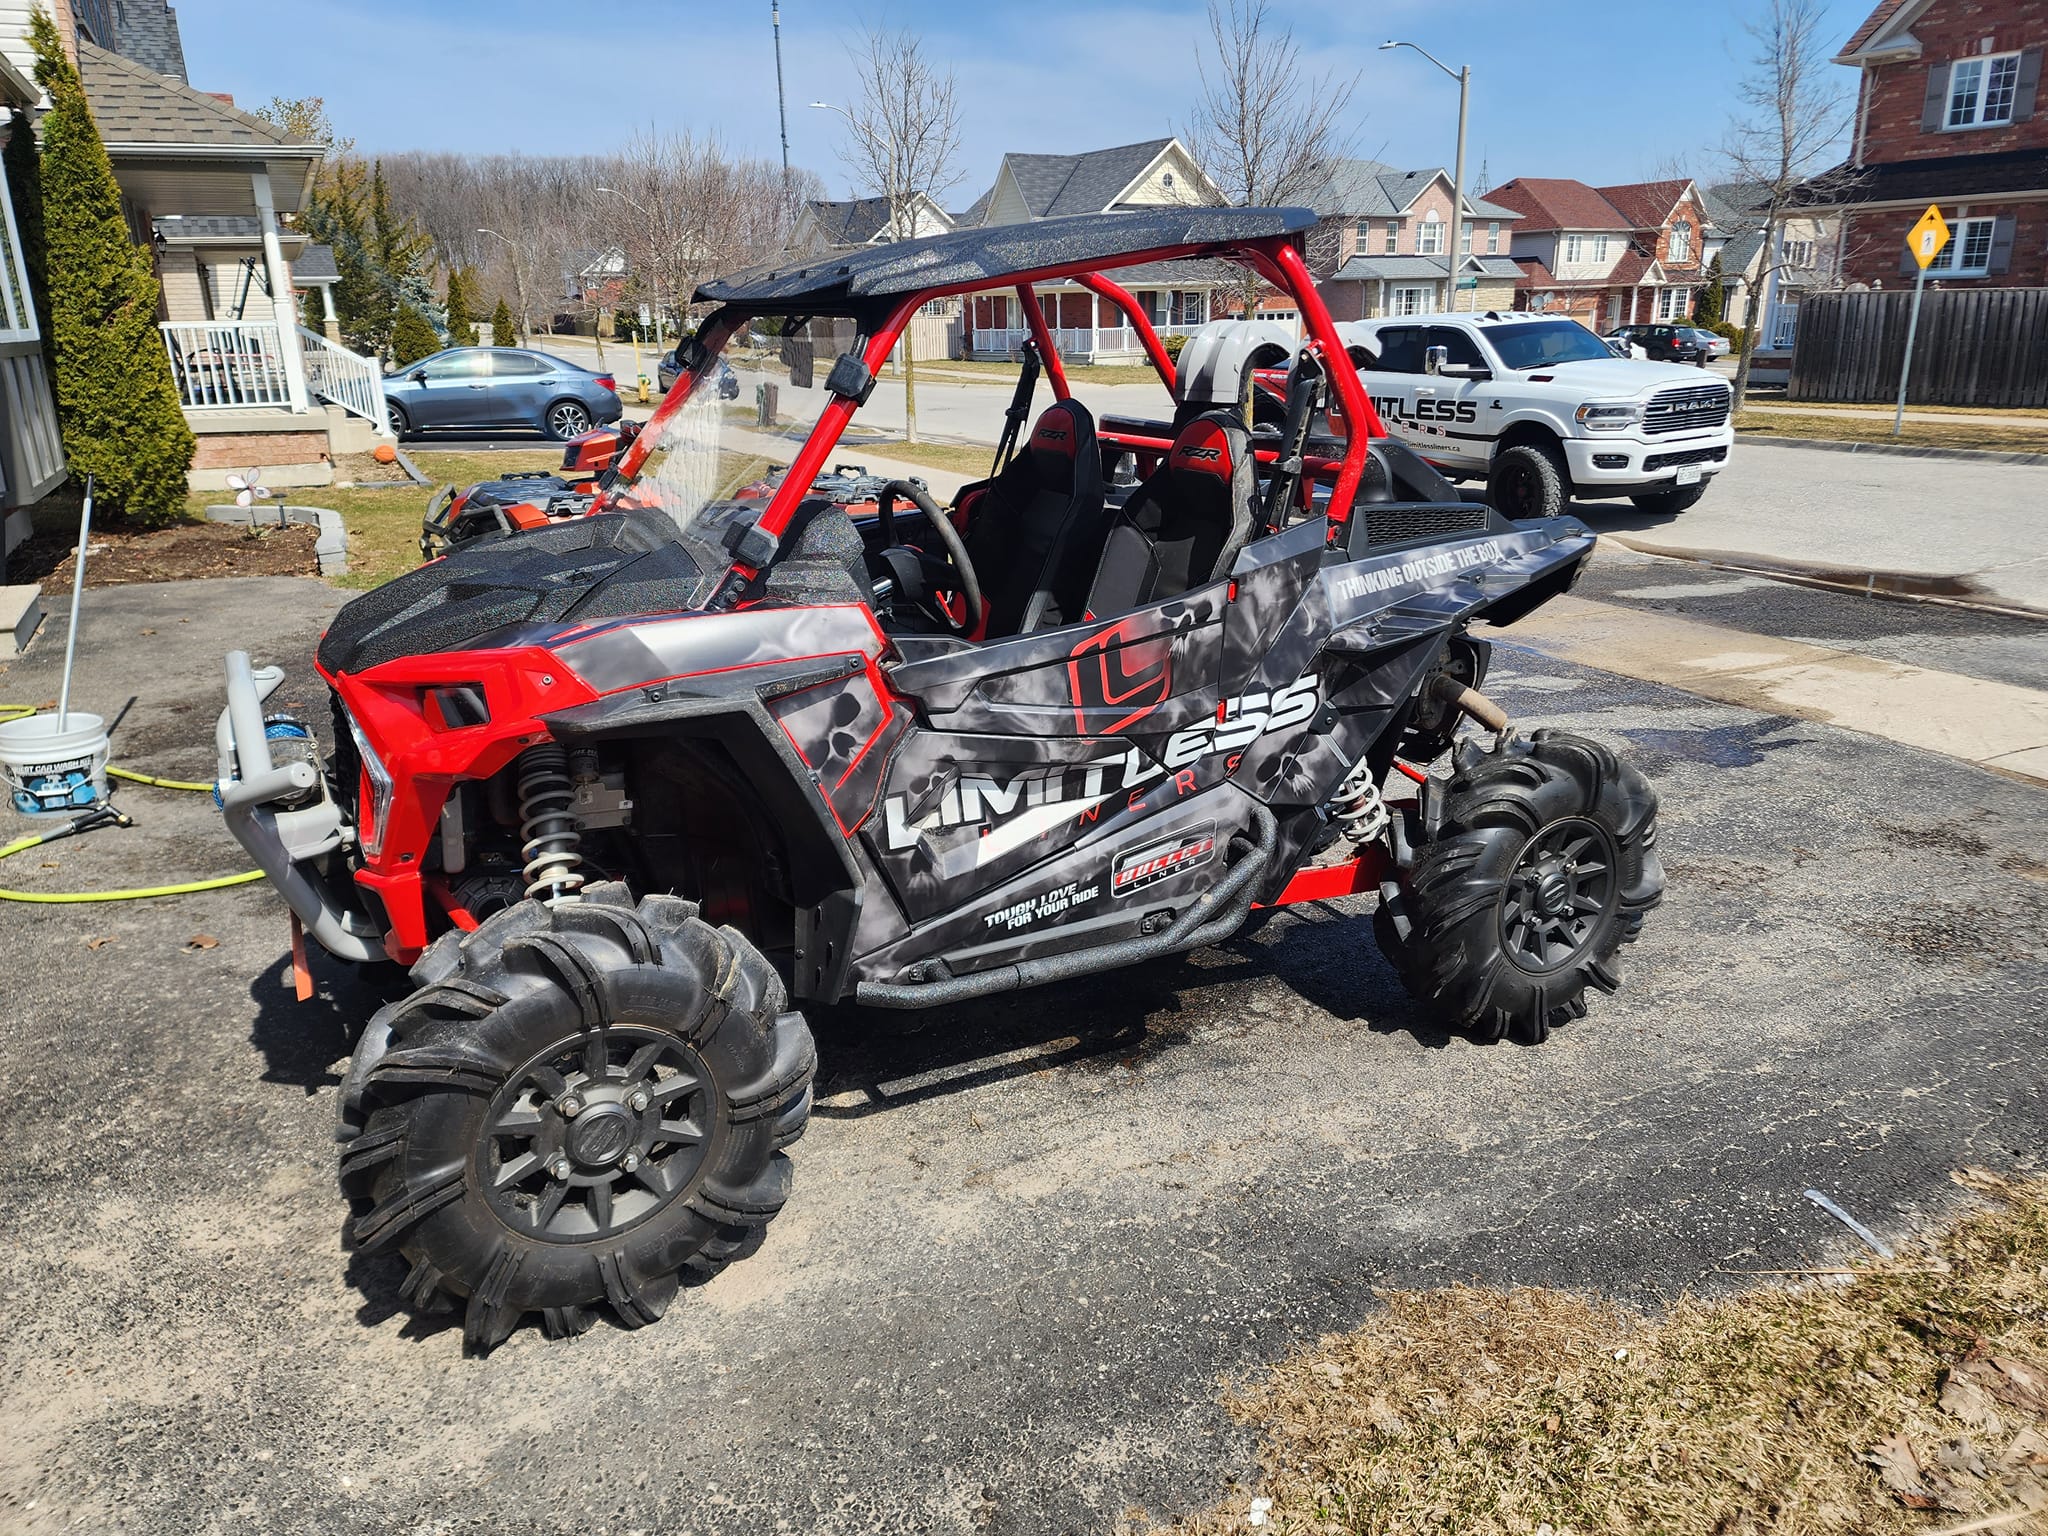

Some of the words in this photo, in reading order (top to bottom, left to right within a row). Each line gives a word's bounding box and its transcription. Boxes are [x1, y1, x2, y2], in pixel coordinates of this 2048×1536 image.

[1675, 400, 1717, 411] RAM
[1039, 430, 1067, 440] RZR
[1384, 421, 1446, 437] NERS
[1178, 446, 1221, 461] RZR
[1337, 568, 1402, 600] THINKING
[1402, 552, 1457, 583] OUTSIDE
[1453, 544, 1479, 568] THE
[1478, 540, 1504, 563] BOX
[885, 673, 1319, 851] LIMITLESS
[1118, 837, 1213, 886] BULLET
[1133, 858, 1196, 888] LINER
[984, 898, 1037, 929] TOUGH
[1040, 882, 1079, 908] LOVE
[1007, 911, 1031, 931] FOR
[1035, 899, 1069, 920] YOUR
[1072, 886, 1099, 907] RIDE
